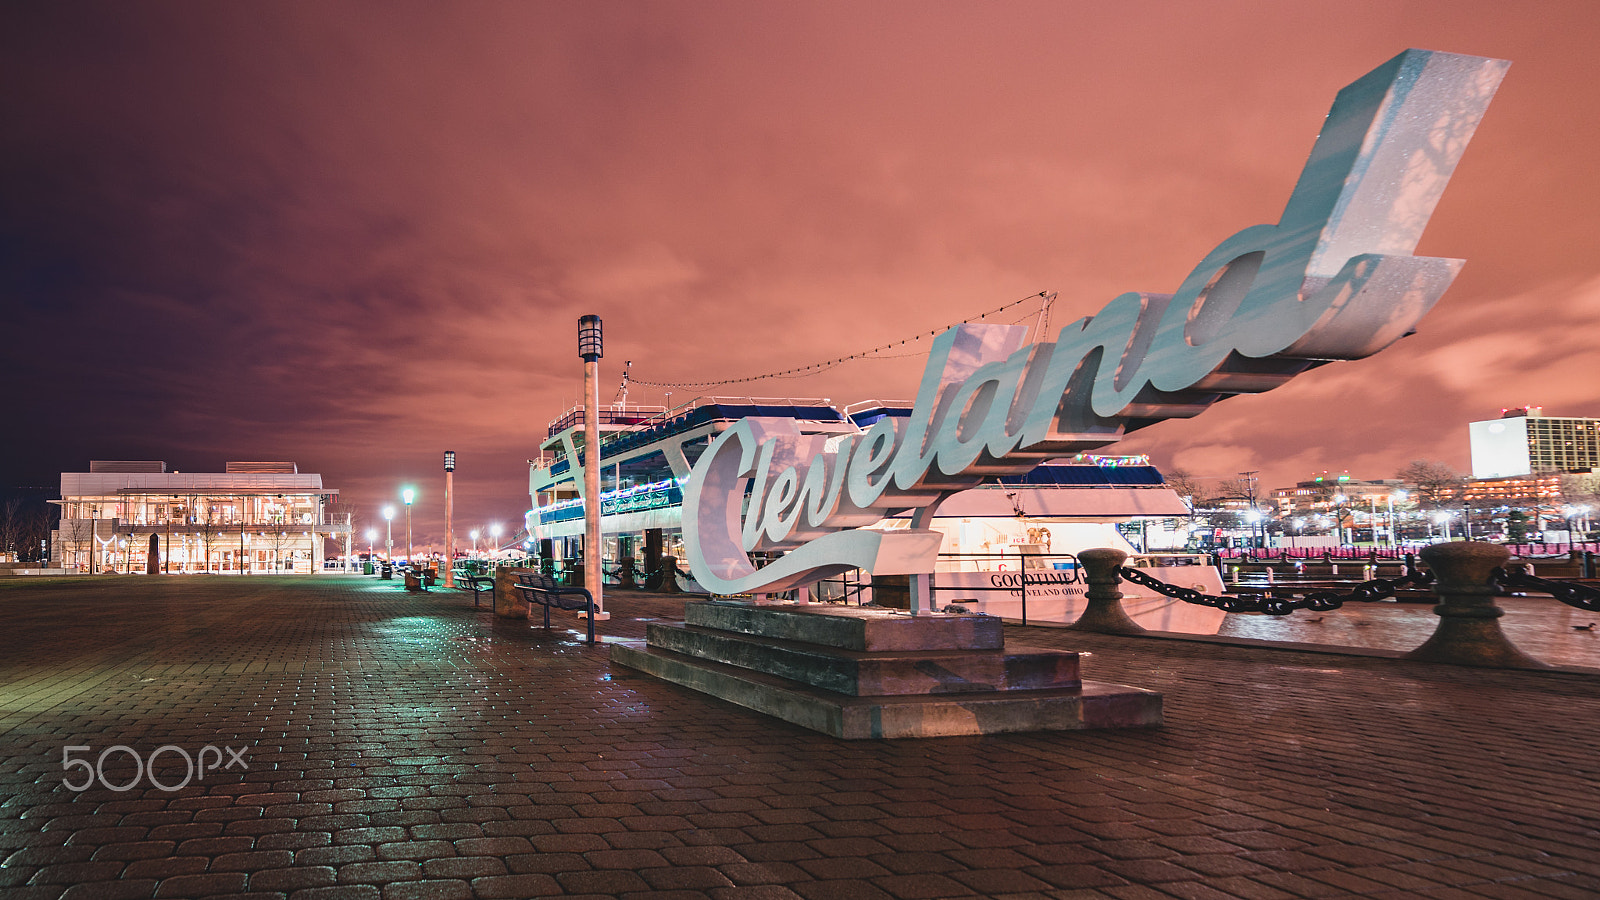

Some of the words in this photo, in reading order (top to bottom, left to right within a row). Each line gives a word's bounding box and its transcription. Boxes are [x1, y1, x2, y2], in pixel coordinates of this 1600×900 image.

[682, 49, 1511, 595] Cleveland
[991, 572, 1074, 587] GOODTIME
[1011, 588, 1060, 597] CLVELAND
[1062, 588, 1084, 596] OHIO
